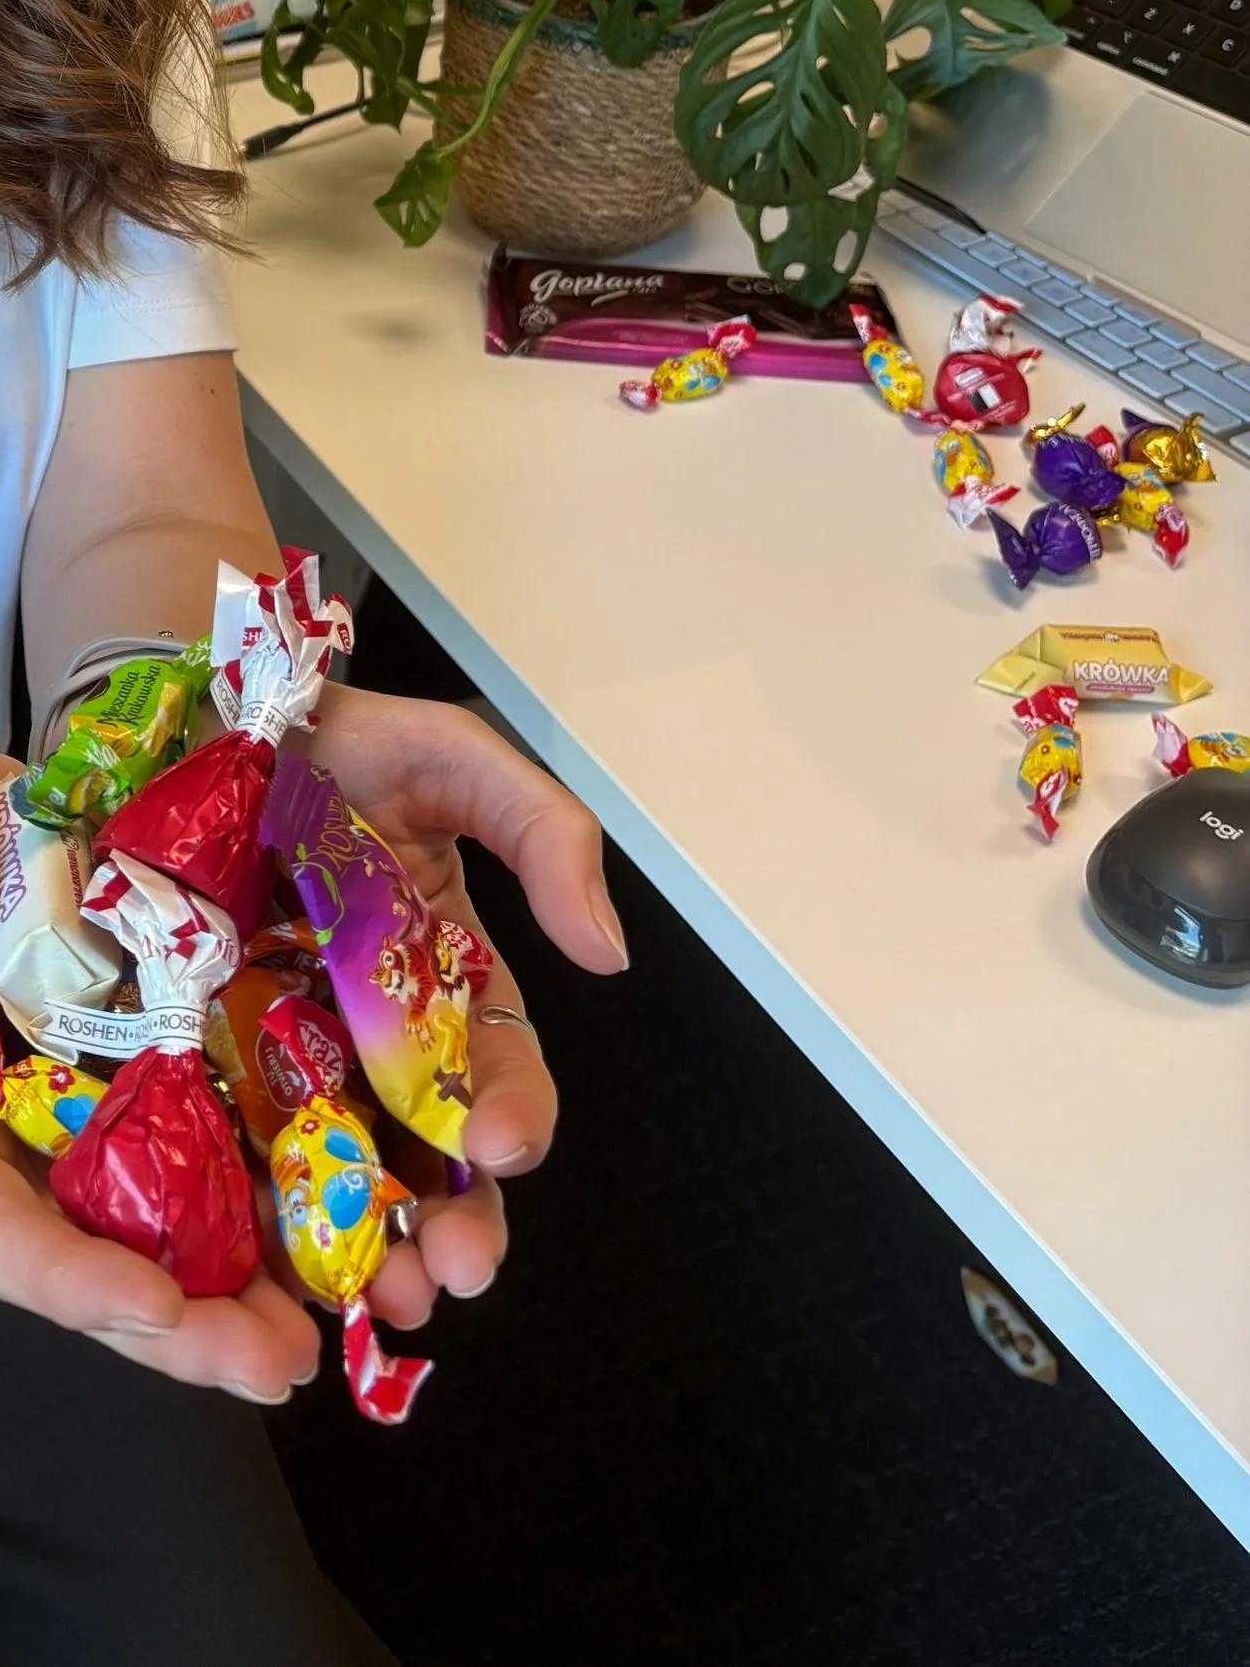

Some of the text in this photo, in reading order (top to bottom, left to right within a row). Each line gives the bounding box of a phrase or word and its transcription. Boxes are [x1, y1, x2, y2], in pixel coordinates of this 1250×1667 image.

[1072, 656, 1169, 685] KRÓWKA
[96, 669, 140, 729] Mieszanka
[116, 664, 162, 727] Krakowska
[1199, 810, 1245, 841] logi
[58, 1013, 128, 1043] ROSHEN
